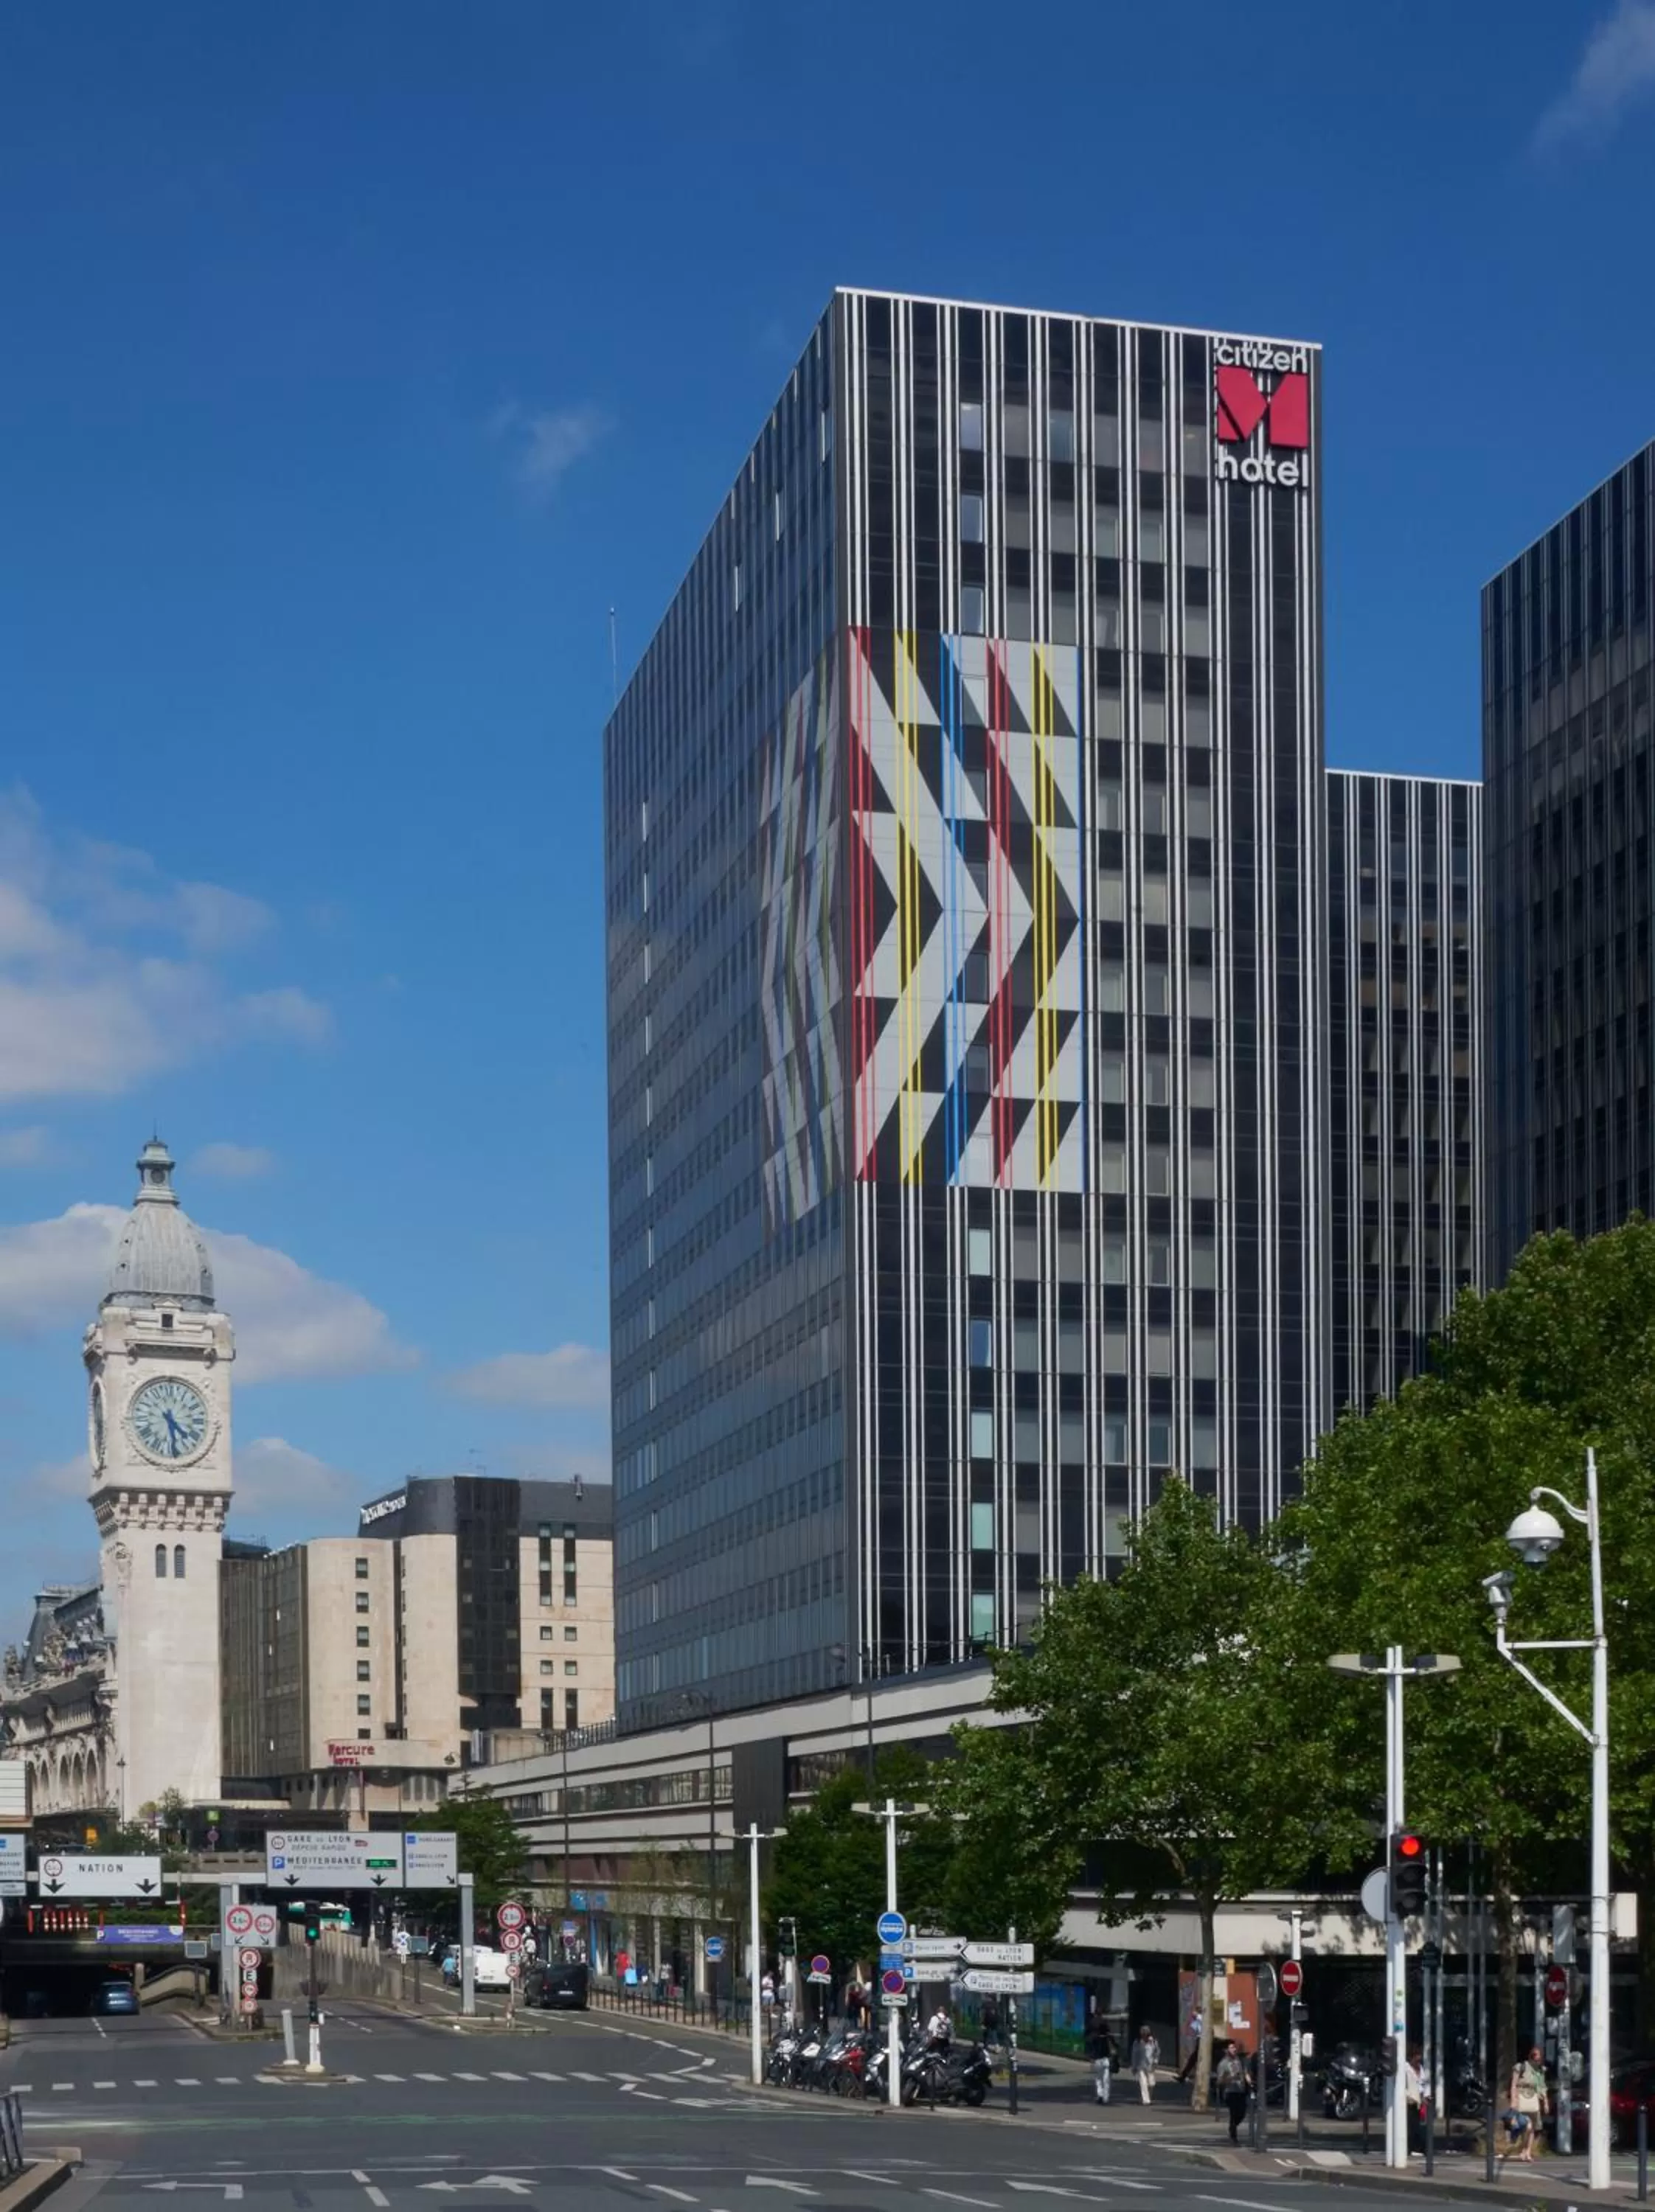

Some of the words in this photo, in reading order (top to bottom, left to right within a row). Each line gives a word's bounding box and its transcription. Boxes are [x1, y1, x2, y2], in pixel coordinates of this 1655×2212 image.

[1216, 344, 1308, 373] citizen
[1217, 445, 1309, 487] hotel
[78, 1863, 124, 1873] NATION
